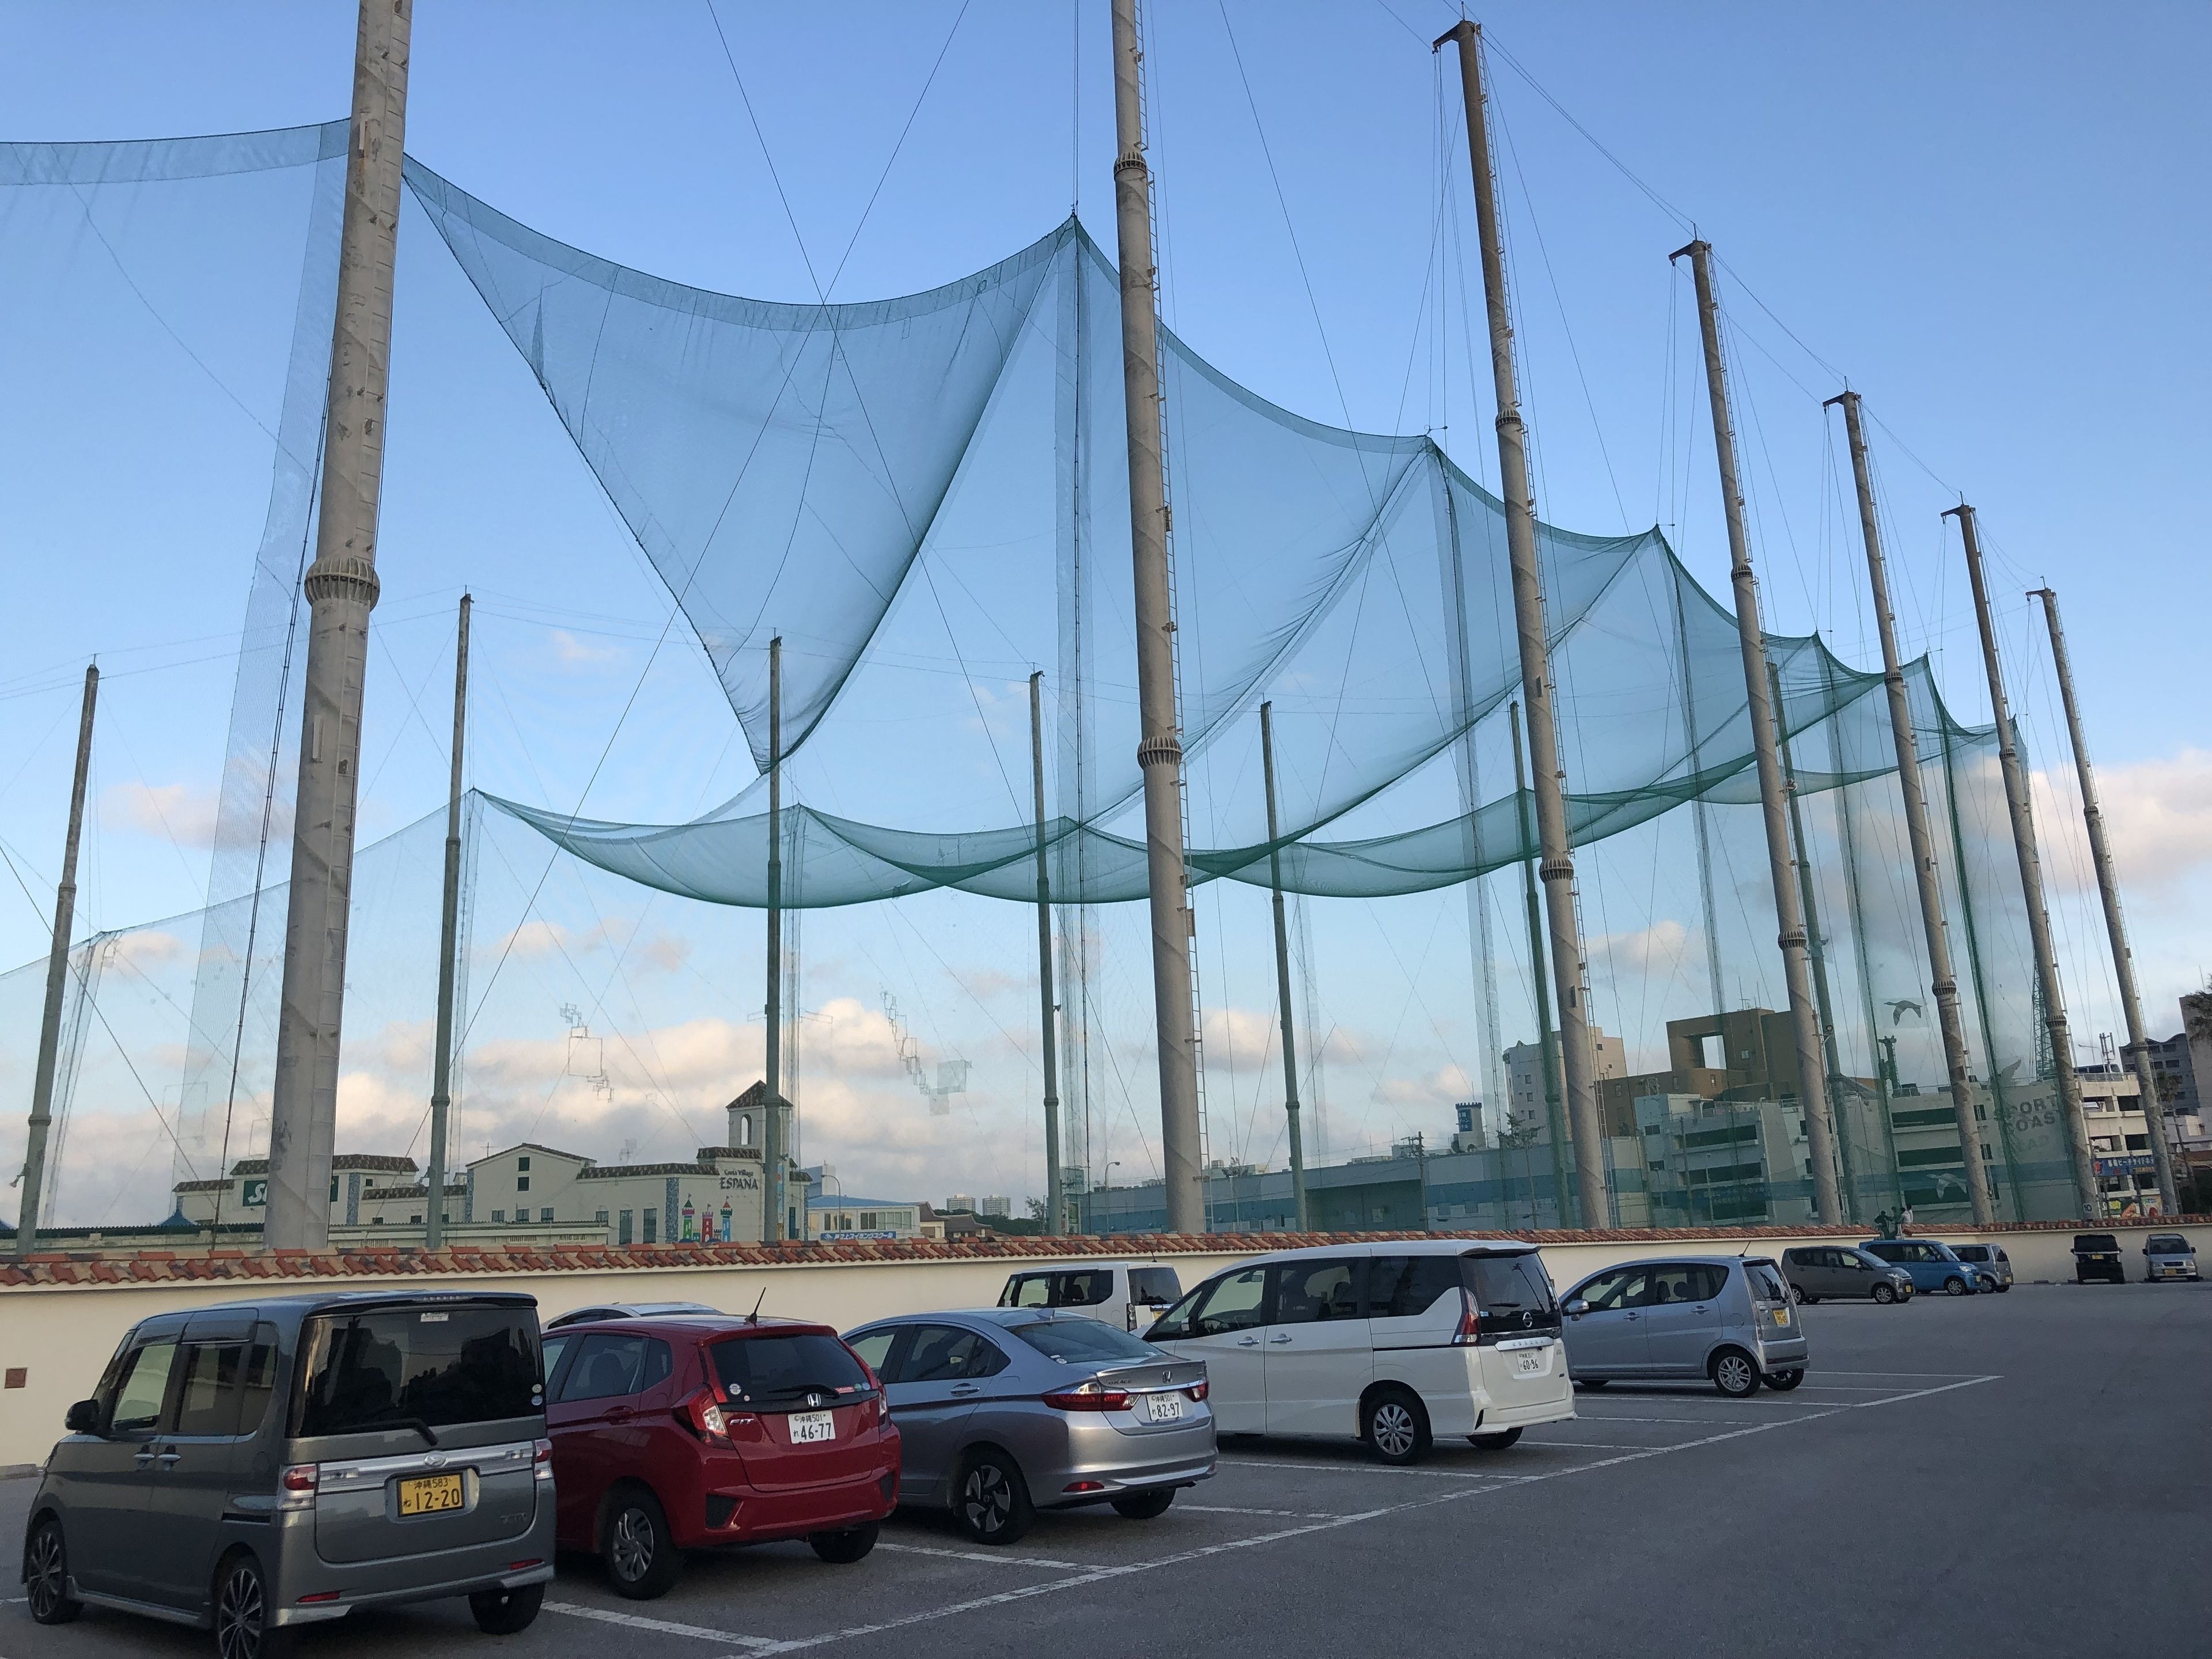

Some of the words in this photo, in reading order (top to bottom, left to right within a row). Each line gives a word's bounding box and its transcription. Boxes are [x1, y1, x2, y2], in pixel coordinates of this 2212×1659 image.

[1157, 1402, 1180, 1417] 82-97
[801, 1422, 831, 1440] 46-77
[416, 1488, 460, 1510] 12-20
